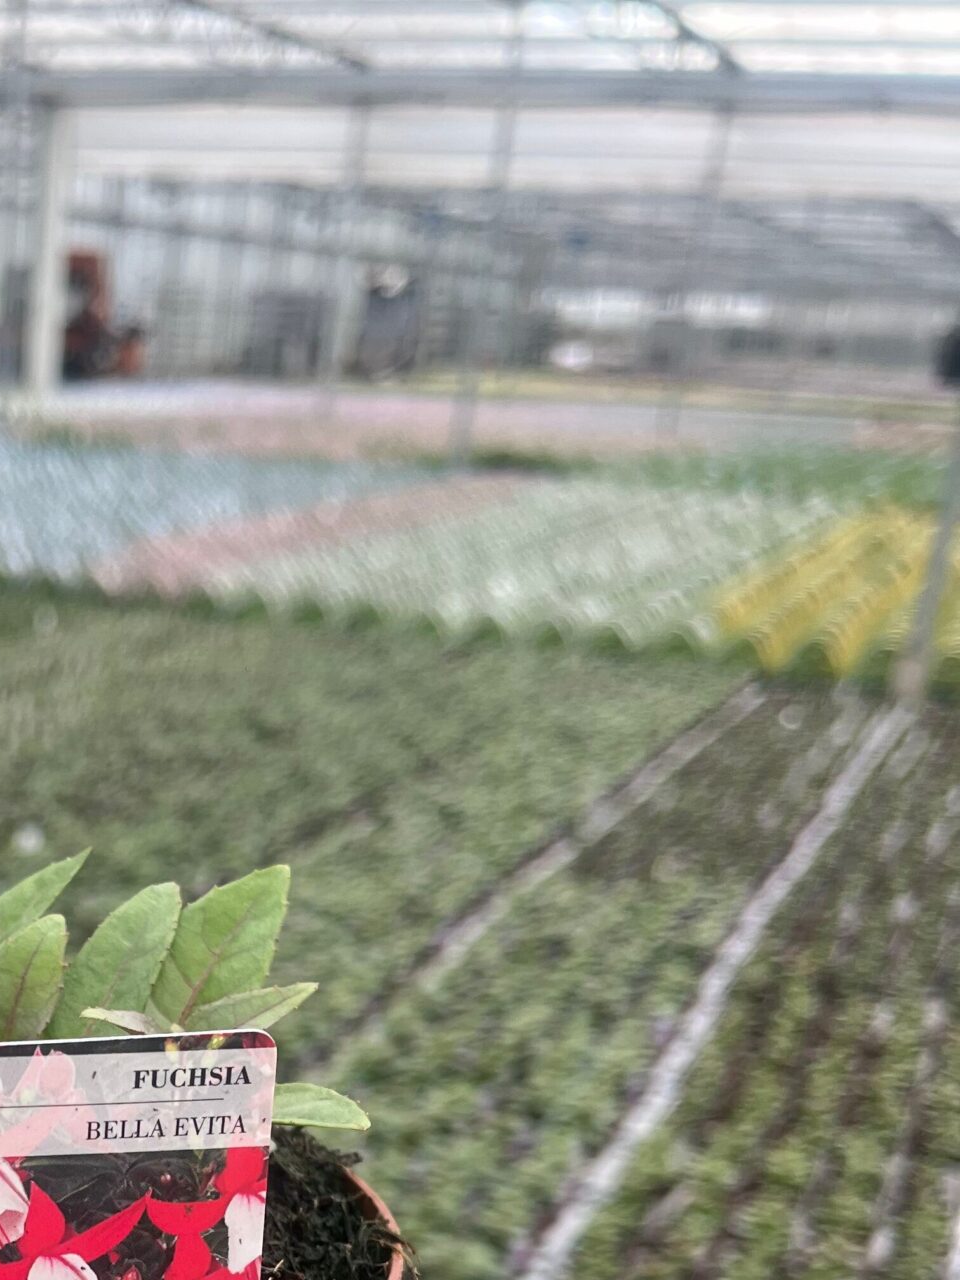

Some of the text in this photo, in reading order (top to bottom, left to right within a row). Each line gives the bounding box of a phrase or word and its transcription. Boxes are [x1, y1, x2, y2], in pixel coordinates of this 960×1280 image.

[132, 1066, 252, 1090] FUCHSIA
[86, 1114, 247, 1141] BELLA EVITA
